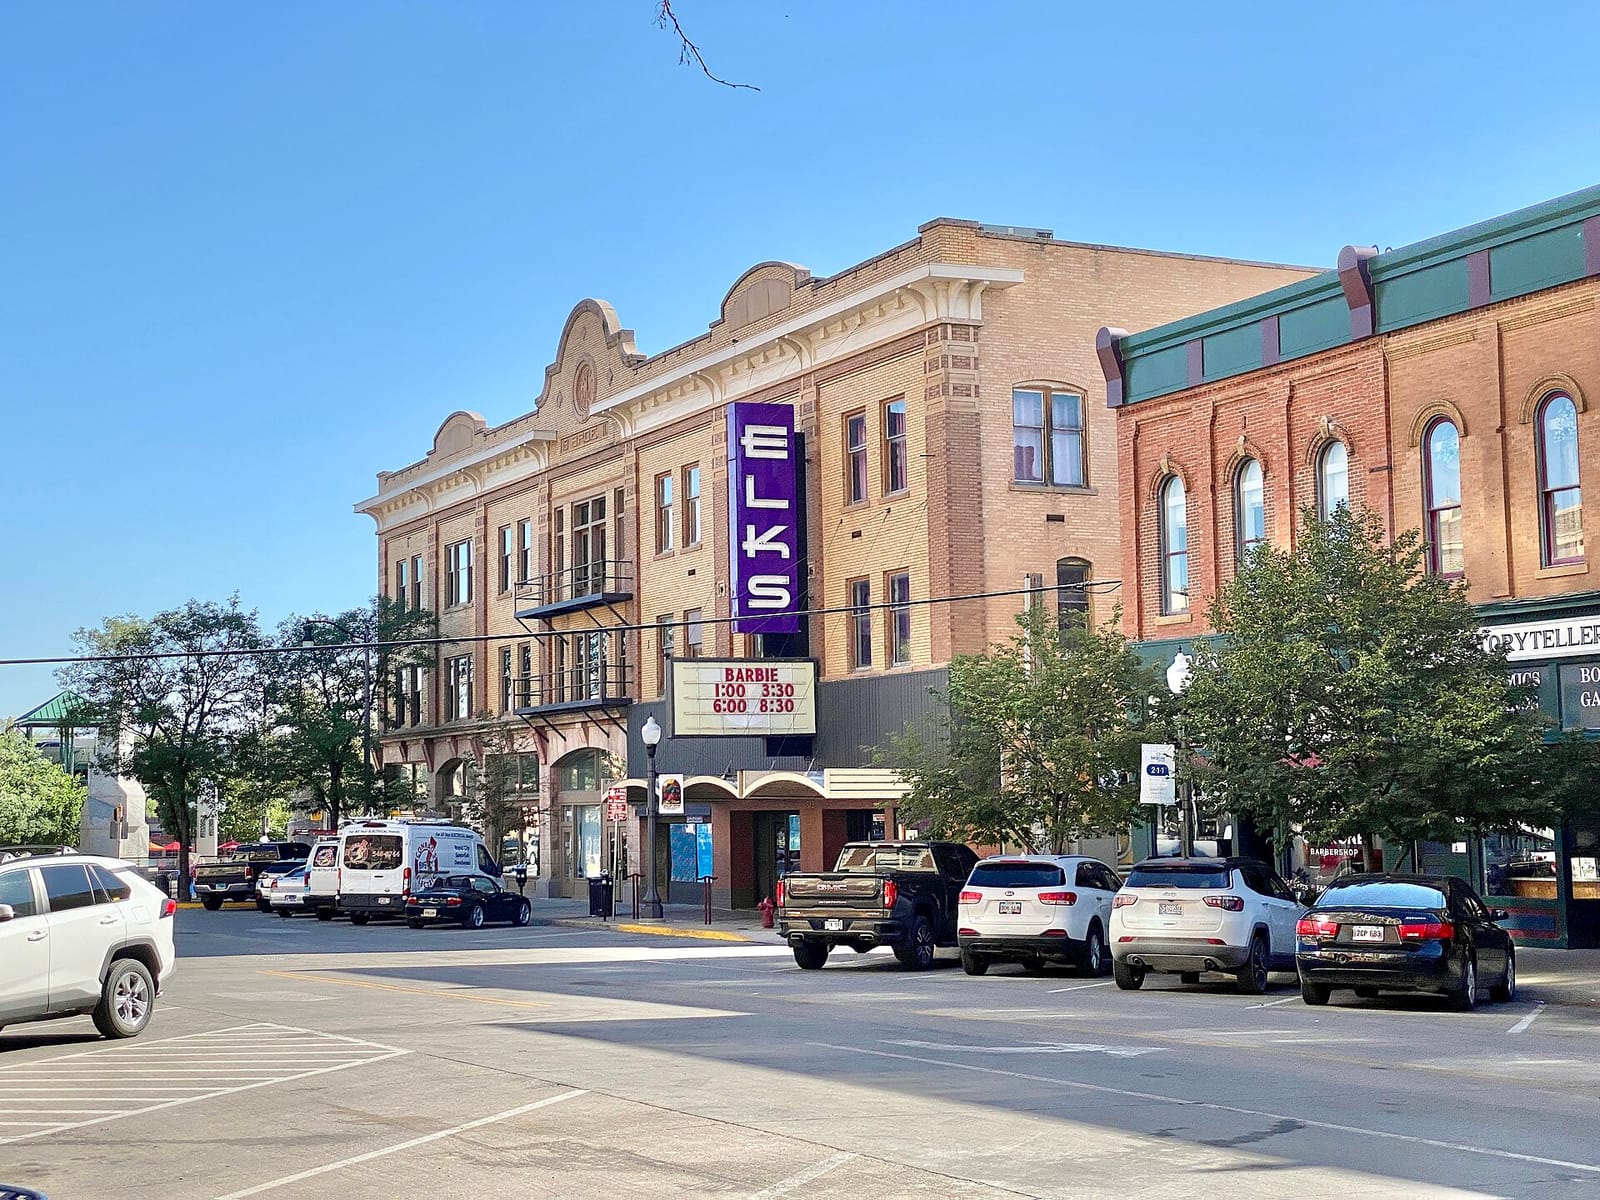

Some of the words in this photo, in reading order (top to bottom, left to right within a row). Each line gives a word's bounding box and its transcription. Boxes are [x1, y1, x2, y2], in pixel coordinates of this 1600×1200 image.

[740, 424, 791, 609] ELKS
[725, 667, 779, 682] BARBIE
[714, 683, 746, 698] 1:00
[761, 683, 795, 698] 3:30
[713, 698, 747, 713] 6:00
[759, 698, 794, 713] 8:30
[1310, 847, 1359, 857] BARBERSHOP
[817, 884, 848, 892] GMC
